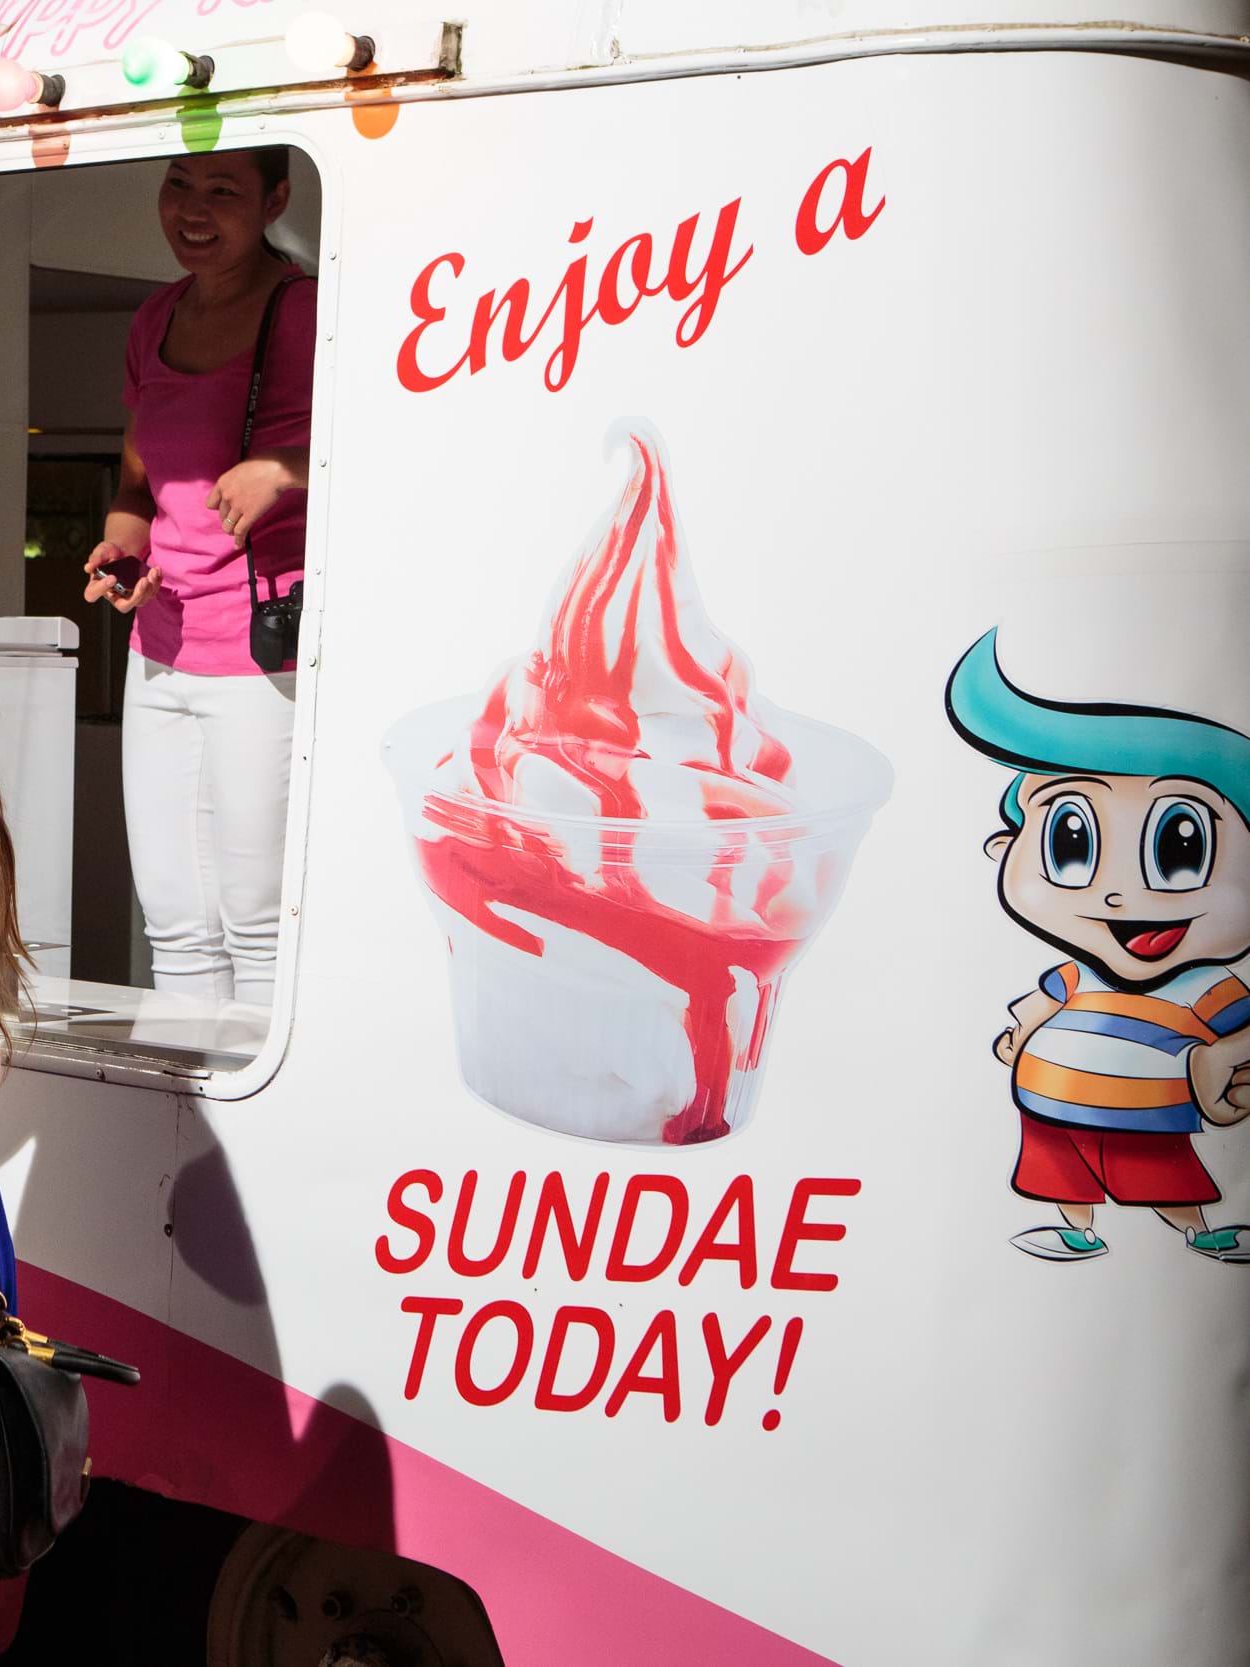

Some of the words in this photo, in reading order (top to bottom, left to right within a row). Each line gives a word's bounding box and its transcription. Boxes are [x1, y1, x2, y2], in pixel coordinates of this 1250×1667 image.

[396, 196, 754, 393] Enjoy
[795, 146, 886, 256] a
[375, 1169, 862, 1291] SUNDAE
[400, 1296, 804, 1431] TODAY!
